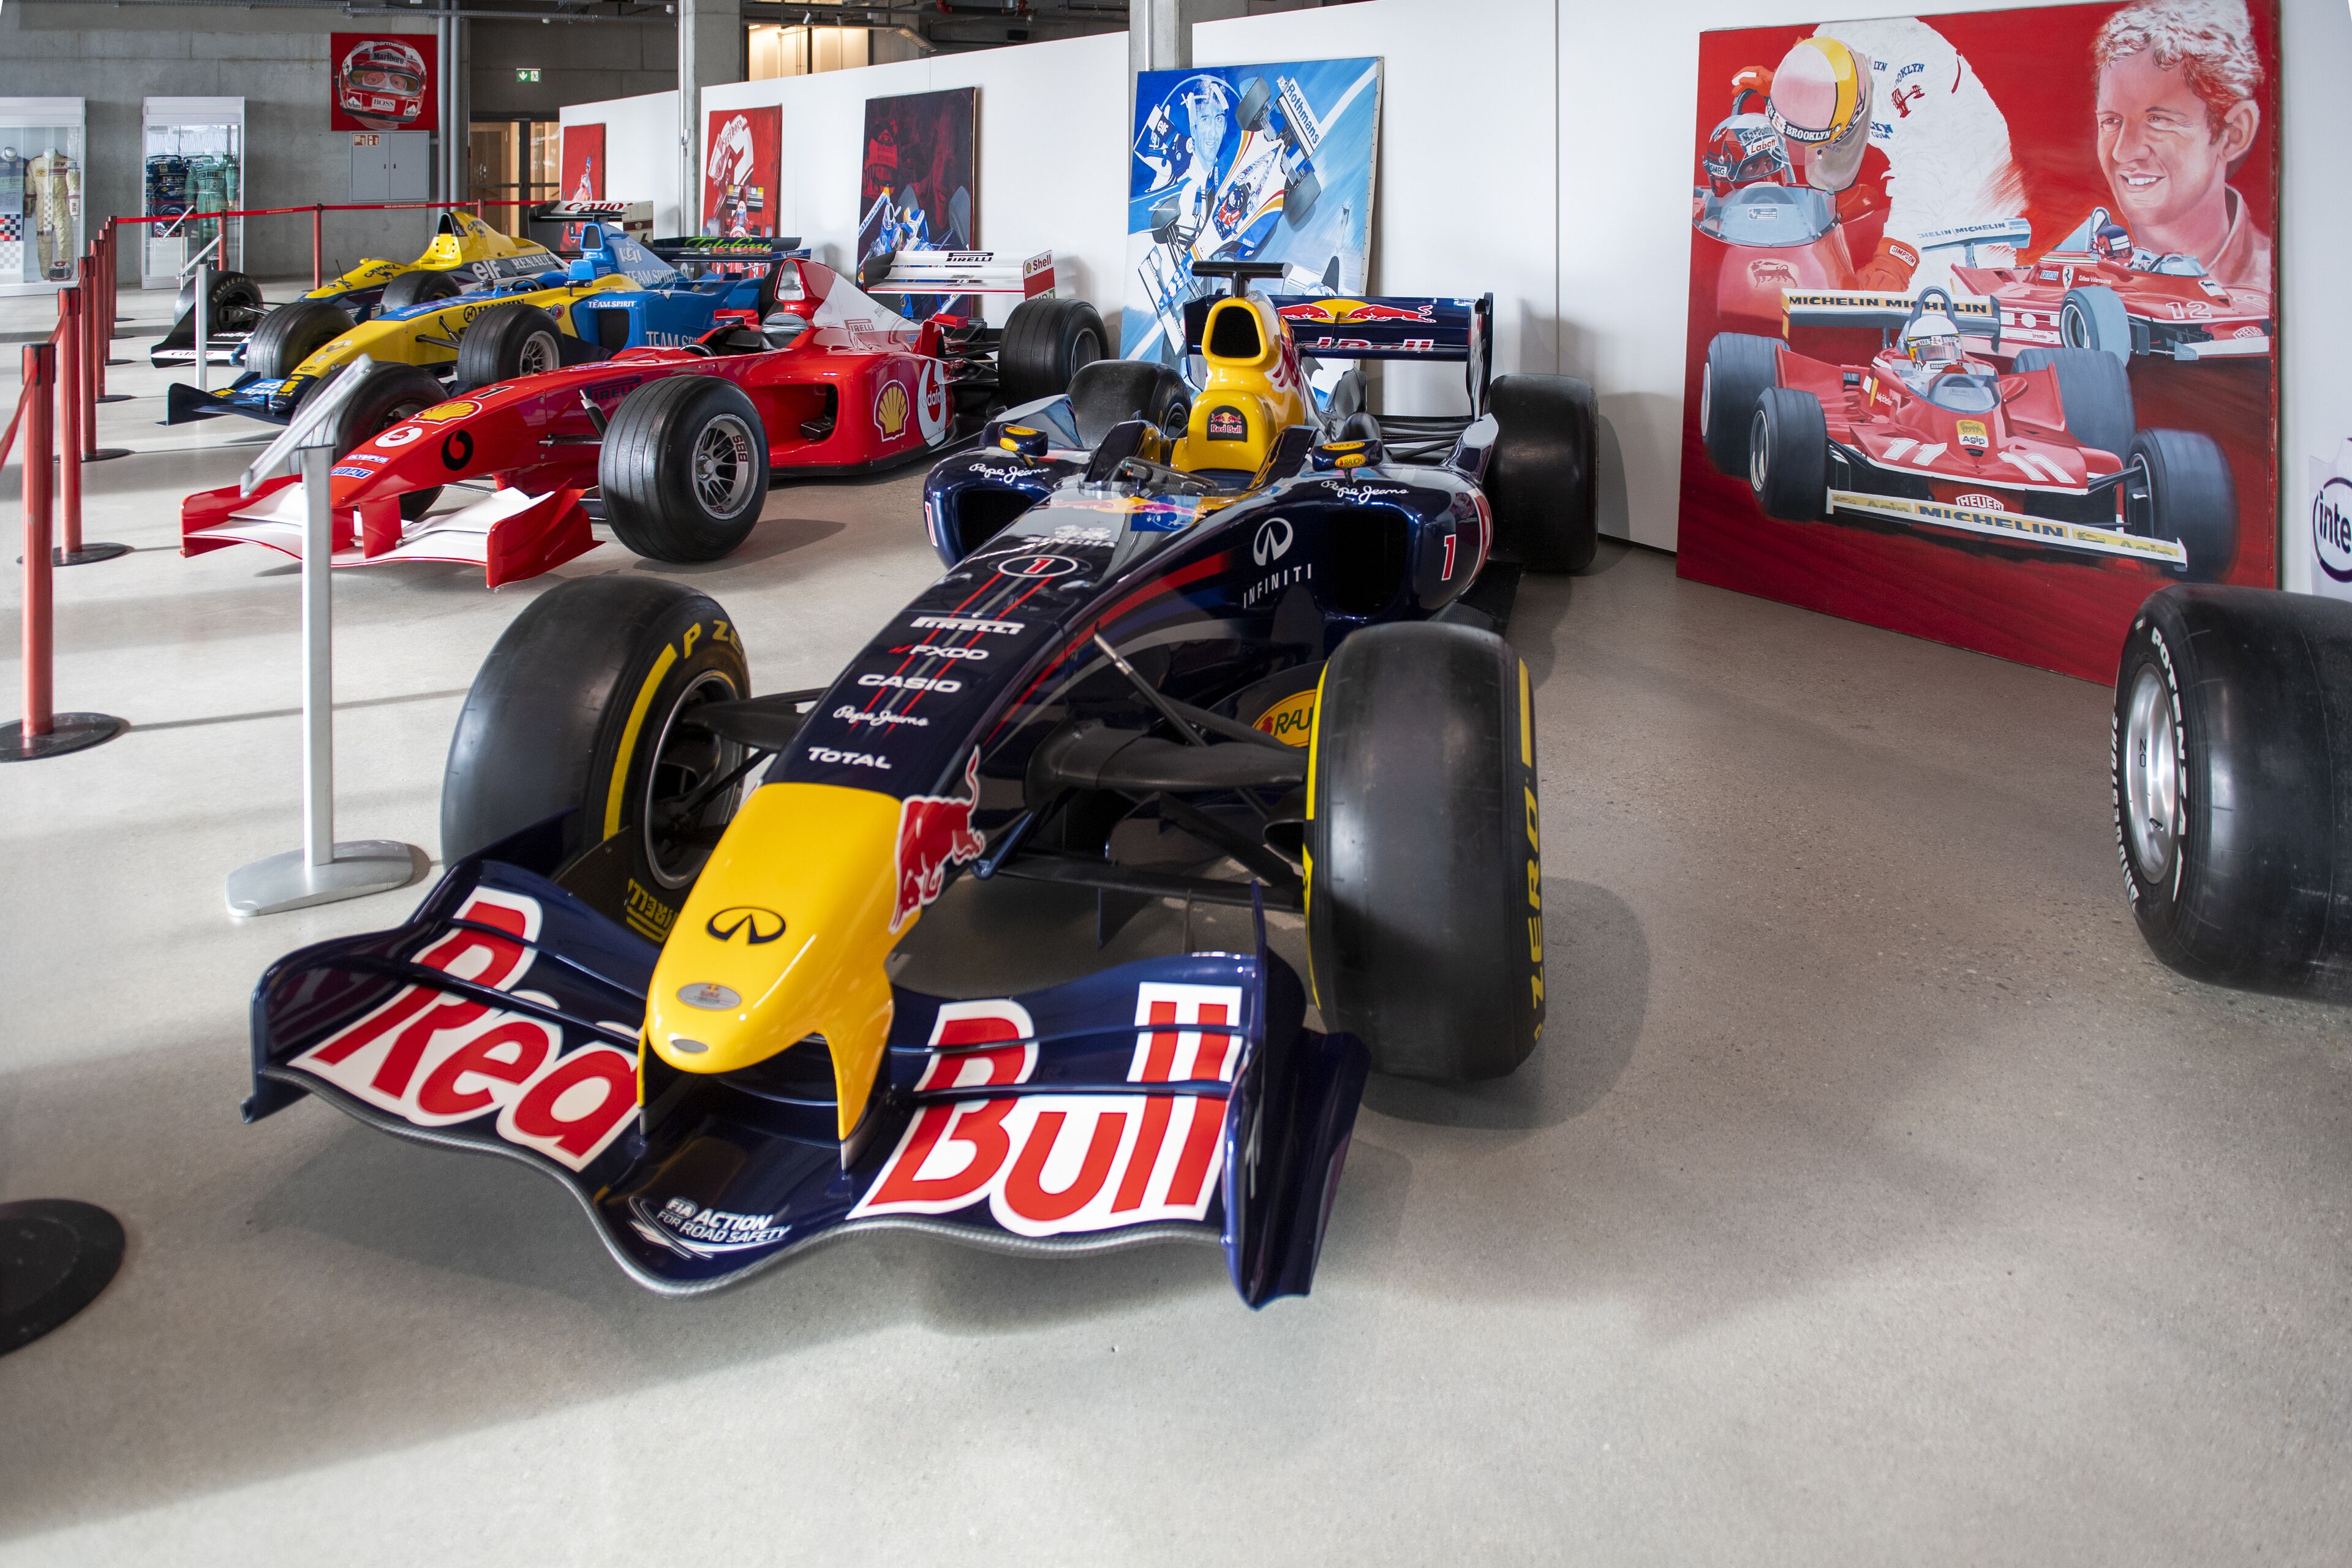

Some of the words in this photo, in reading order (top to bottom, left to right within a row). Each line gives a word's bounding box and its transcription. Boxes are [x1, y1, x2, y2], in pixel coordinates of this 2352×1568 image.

[374, 52, 404, 65] Marlboro
[374, 98, 394, 107] BOSS
[1286, 83, 1320, 145] Rothmans
[1156, 120, 1169, 134] elf
[1785, 126, 1831, 141] BROOKLYN
[564, 202, 633, 212] Cano
[1954, 222, 2006, 234] MICHELIN
[946, 252, 994, 262] PIRELLI
[1033, 254, 1052, 271] Shell
[1891, 246, 1916, 263] SIMPSON
[364, 264, 401, 277] CAMEL
[472, 260, 502, 279] elf
[624, 270, 654, 284] TEAM
[213, 277, 236, 303] EAGLE
[588, 299, 609, 309] TEAM
[1789, 296, 1879, 306] MICHELIN
[2165, 301, 2213, 320] 12
[844, 318, 875, 333] PIRELLI
[646, 331, 678, 347] TEAM
[1210, 424, 1226, 433] Red
[1227, 424, 1242, 434] Bull
[733, 434, 748, 462] BBS
[1962, 435, 1986, 445] Agip
[1882, 437, 1948, 466] 11
[1344, 458, 1363, 466] RAUCH
[1997, 451, 2077, 484] 11
[331, 468, 371, 478] FIAT
[968, 463, 1005, 478] Pepe
[1003, 466, 1051, 484] Jeans
[1320, 480, 1359, 499] Pepe
[1359, 484, 1409, 503] Jeans
[1960, 496, 2002, 510] HEUER
[925, 502, 938, 547] 1
[1919, 505, 2064, 537] MICHELIN
[1021, 536, 1116, 548] SINGHA
[1024, 557, 1056, 575] 1
[1441, 533, 1457, 581] 1
[1243, 563, 1311, 609] INFINITI
[910, 616, 1025, 635] PIRELLI
[682, 621, 702, 660] P
[910, 644, 990, 660] FXDD
[858, 674, 962, 693] CASIO
[833, 705, 873, 724] Pepe
[867, 709, 929, 727] Jeans
[2150, 626, 2187, 836] POTENZA
[807, 746, 892, 770] TOTAL
[1523, 786, 1545, 1010] ZERO
[846, 981, 1243, 1237] Bull
[657, 1211, 681, 1227] FOR
[679, 1221, 728, 1243] ROAD
[726, 1224, 793, 1243] SAFETY
[693, 1208, 774, 1231] ACTION
